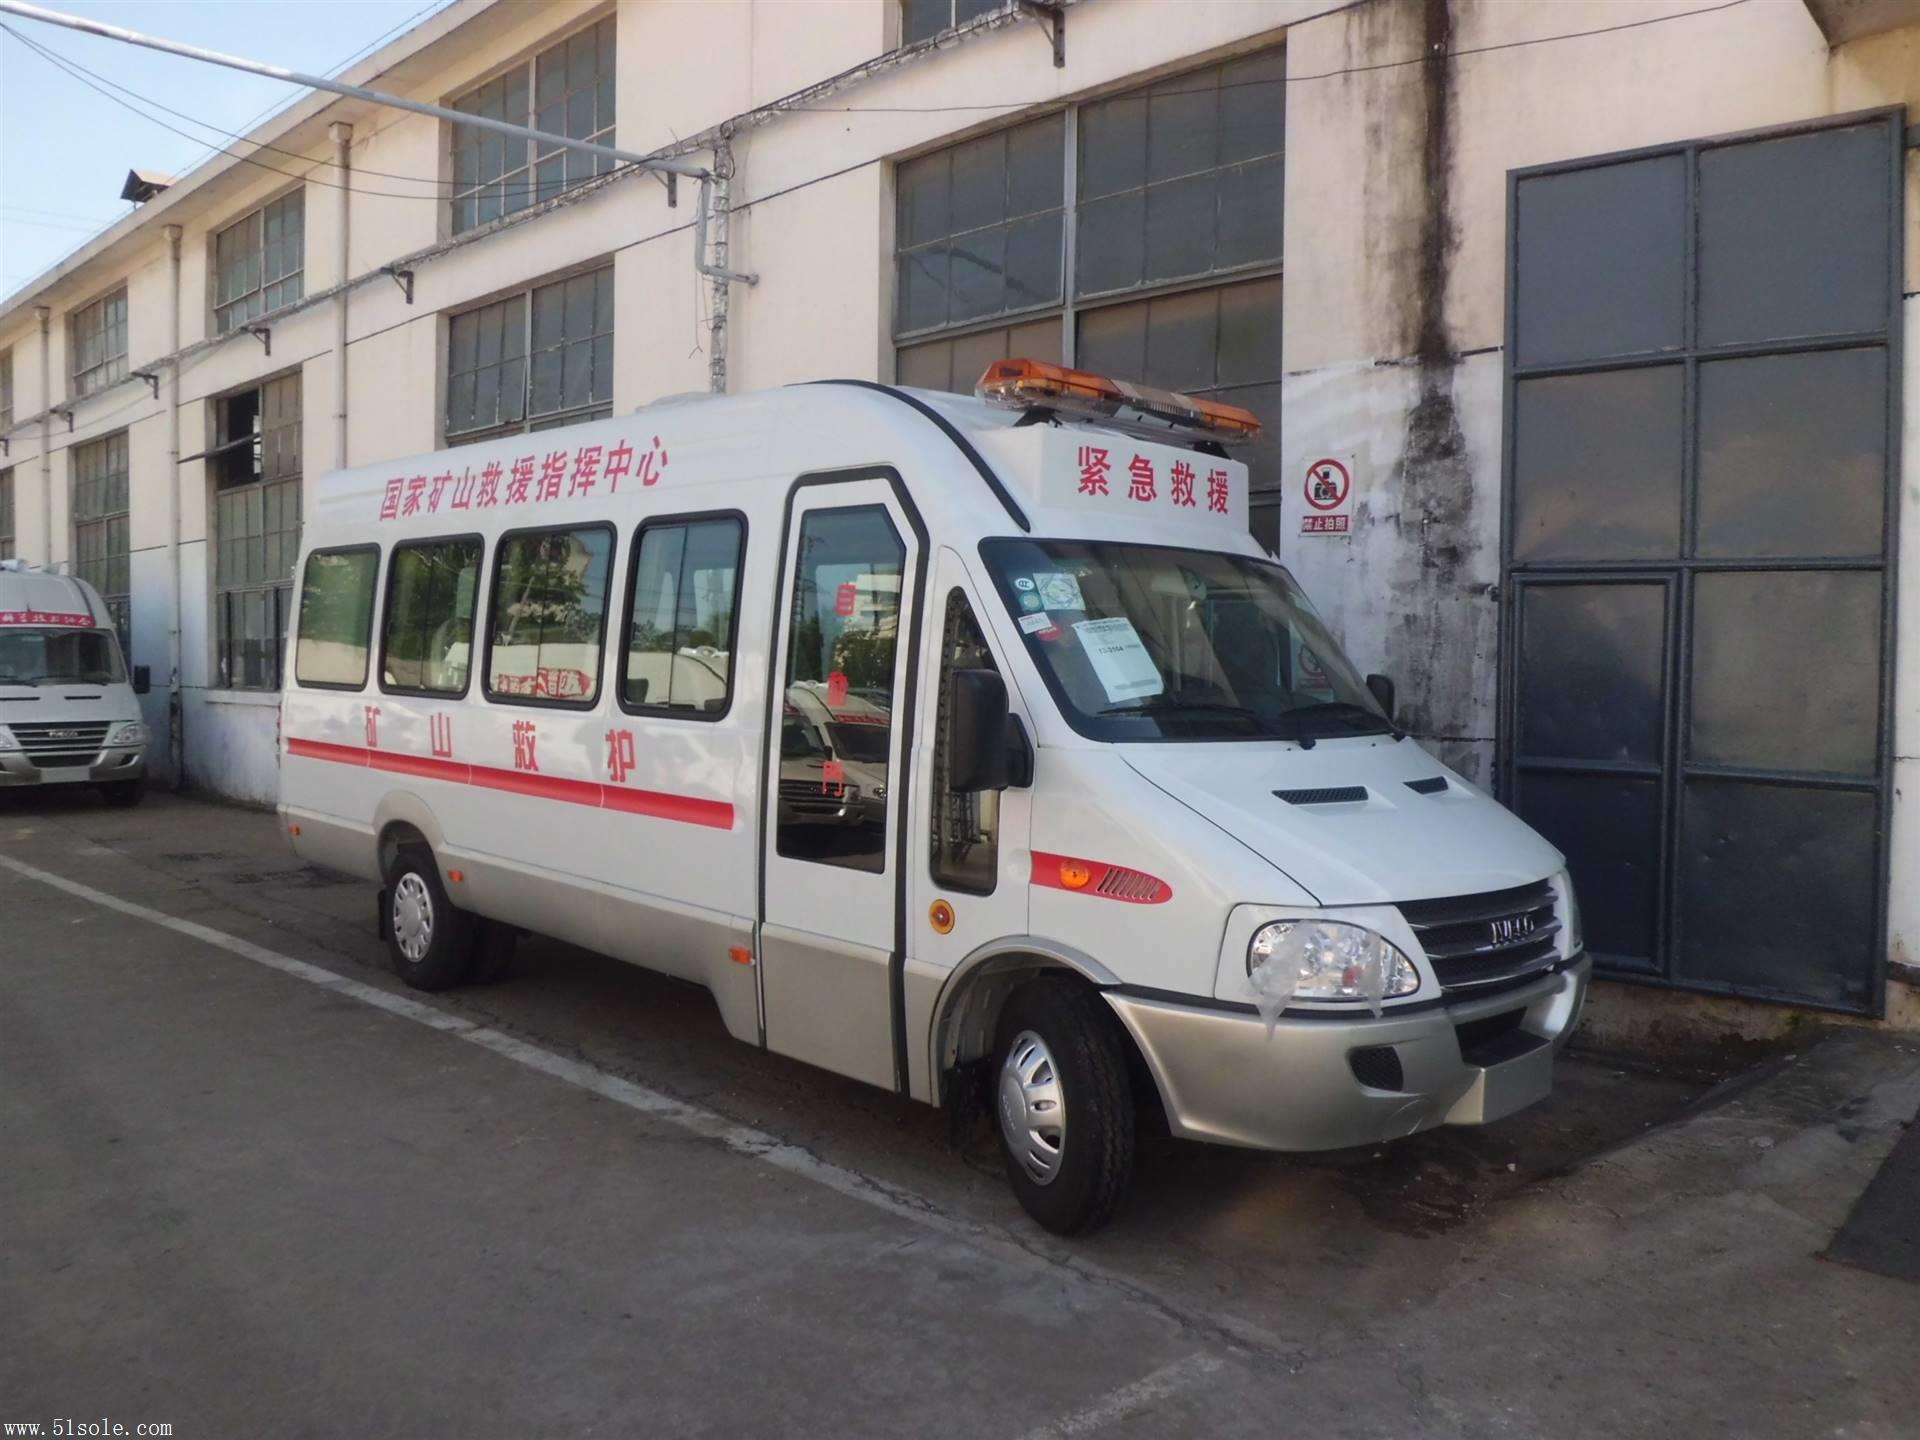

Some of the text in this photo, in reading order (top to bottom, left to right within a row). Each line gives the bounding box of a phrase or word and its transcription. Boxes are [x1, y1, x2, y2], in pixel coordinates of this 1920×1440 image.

[379, 435, 669, 522] 国家矿山救援指挥中心
[1077, 445, 1230, 515] 紧急救援
[364, 705, 636, 783] 矿山救护
